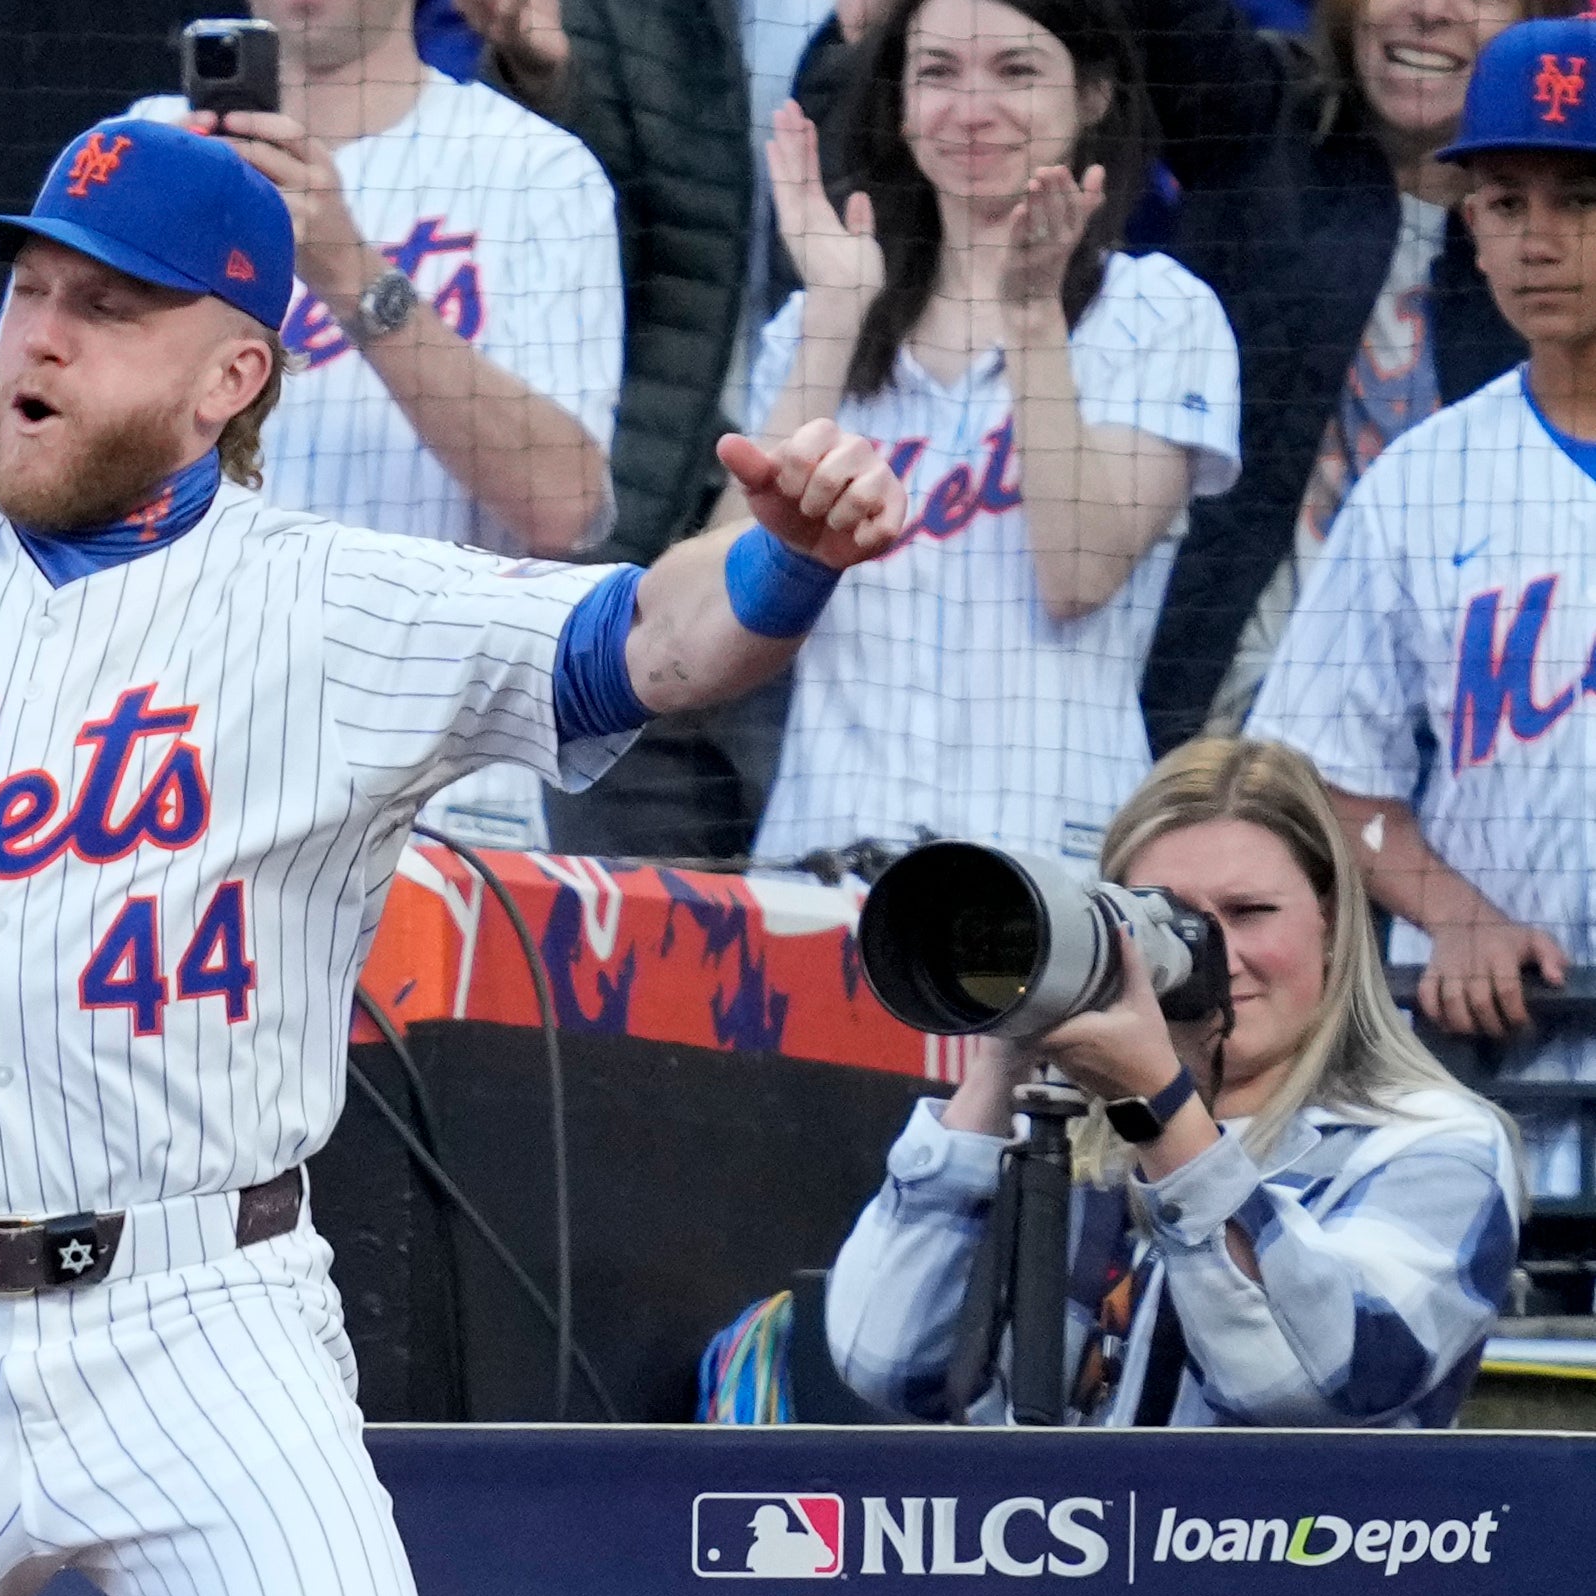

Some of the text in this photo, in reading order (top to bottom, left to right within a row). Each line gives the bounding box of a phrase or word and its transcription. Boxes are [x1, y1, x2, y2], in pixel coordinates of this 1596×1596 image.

[78, 880, 257, 1038] 44
[859, 1496, 1499, 1577] NLCS loanDepot
